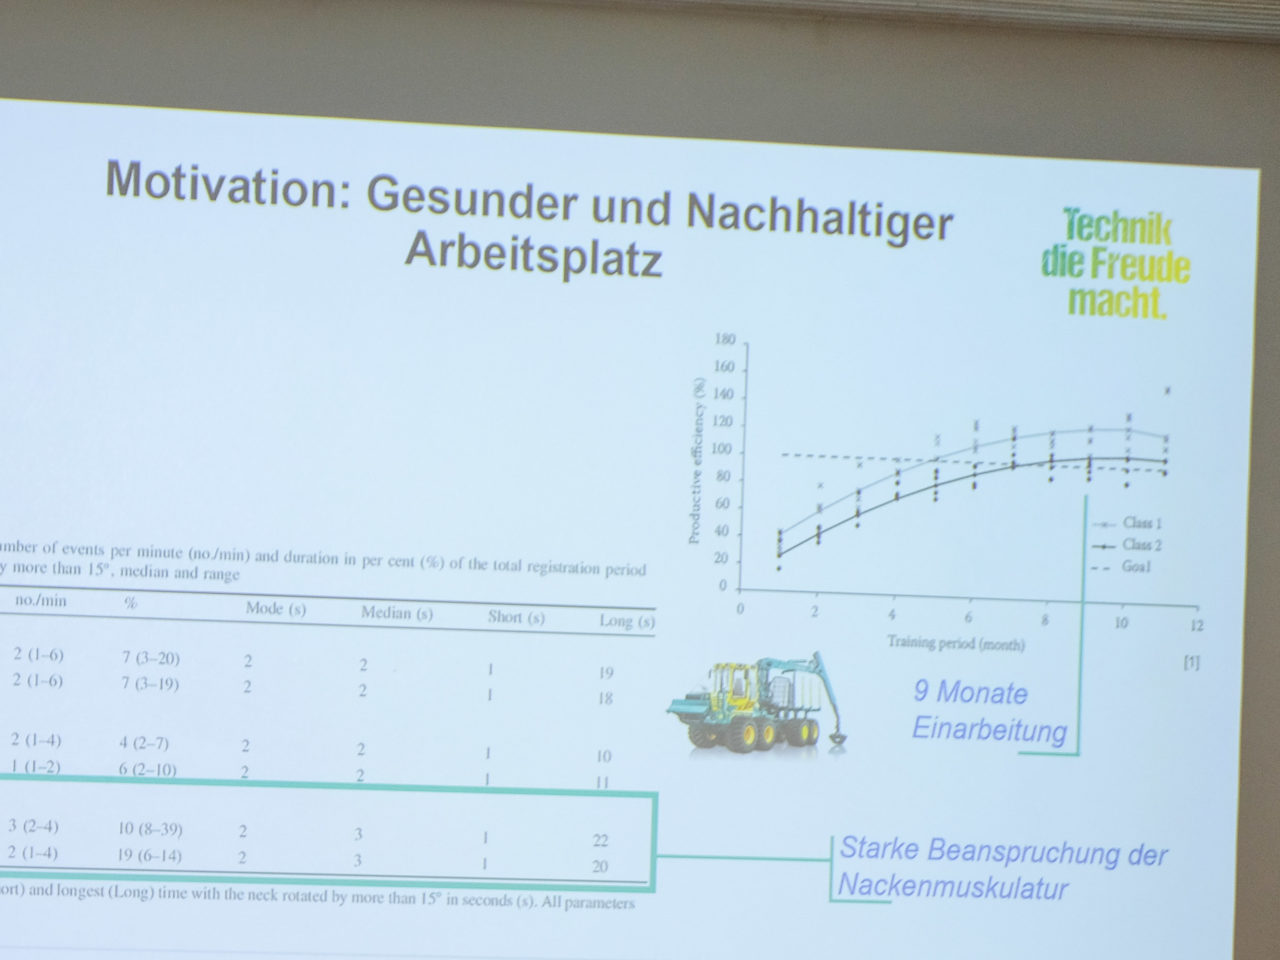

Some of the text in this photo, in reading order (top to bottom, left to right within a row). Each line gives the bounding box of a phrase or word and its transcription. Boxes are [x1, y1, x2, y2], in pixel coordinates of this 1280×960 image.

[107, 159, 954, 247] Motivation: Gesunder und Nachhaltiger
[1063, 206, 1171, 245] Technik
[405, 230, 662, 283] Arbeitsplatz
[1042, 243, 1190, 284] die Freude
[1069, 288, 1166, 320] macht.
[716, 332, 736, 346] 180
[715, 360, 735, 373] 160
[714, 387, 734, 400] 140
[713, 414, 733, 427] 120
[692, 403, 707, 465] efficiency
[712, 442, 732, 455] 100
[716, 469, 731, 482] 80
[689, 470, 702, 544] Productive
[715, 496, 730, 510] 60
[1123, 515, 1162, 530] Class 1
[714, 524, 729, 537] 40
[1122, 537, 1162, 552] Class 2
[42, 540, 58, 555] of
[62, 545, 105, 556] events
[110, 547, 132, 561] per
[137, 544, 183, 559] minute
[255, 549, 279, 563] and
[284, 550, 339, 565] duration
[344, 552, 356, 566] in
[362, 556, 383, 570] per
[388, 557, 414, 568] cent
[420, 556, 445, 570] (%)
[449, 556, 465, 569] of
[469, 557, 488, 571] the
[493, 559, 522, 572] total
[527, 560, 600, 577] registration
[605, 563, 646, 579] period
[714, 551, 729, 565] 20
[13, 563, 47, 574] more
[53, 562, 81, 576] than
[120, 565, 169, 578] median
[174, 567, 198, 579] and
[204, 570, 240, 584] range
[1122, 559, 1151, 573] Goal
[124, 596, 138, 610] %
[246, 601, 306, 618] Mode (s)
[361, 605, 433, 622] Median (s)
[488, 609, 545, 626] Short (s)
[600, 613, 656, 631] Long (s)
[1116, 616, 1129, 629] 10
[1191, 619, 1204, 632] 12
[887, 634, 1026, 654] Training period (month)
[600, 666, 614, 680] 19
[599, 691, 613, 706] 18
[914, 678, 1028, 705] 9 Monate
[912, 715, 1068, 749] Einarbeitung
[597, 749, 612, 763] 10
[120, 821, 134, 835] 10
[593, 833, 608, 847] 22
[119, 848, 133, 862] 19
[840, 835, 1170, 870] Starke Beanspruchung der
[592, 860, 609, 873] 20
[838, 872, 1070, 901] Nackenmuskulatur
[29, 883, 53, 896] and
[57, 883, 104, 901] longest
[108, 884, 155, 902] (Long)
[158, 885, 187, 900] time
[191, 886, 220, 900] with
[225, 887, 245, 901] the
[248, 888, 278, 901] neck
[283, 890, 328, 903] rotated
[332, 889, 348, 907] by
[352, 894, 384, 904] more
[389, 891, 416, 904] than
[447, 892, 458, 906] in
[462, 894, 513, 907] seconds
[516, 895, 538, 909] (s).
[541, 895, 562, 908] All
[565, 899, 635, 912] parameters
